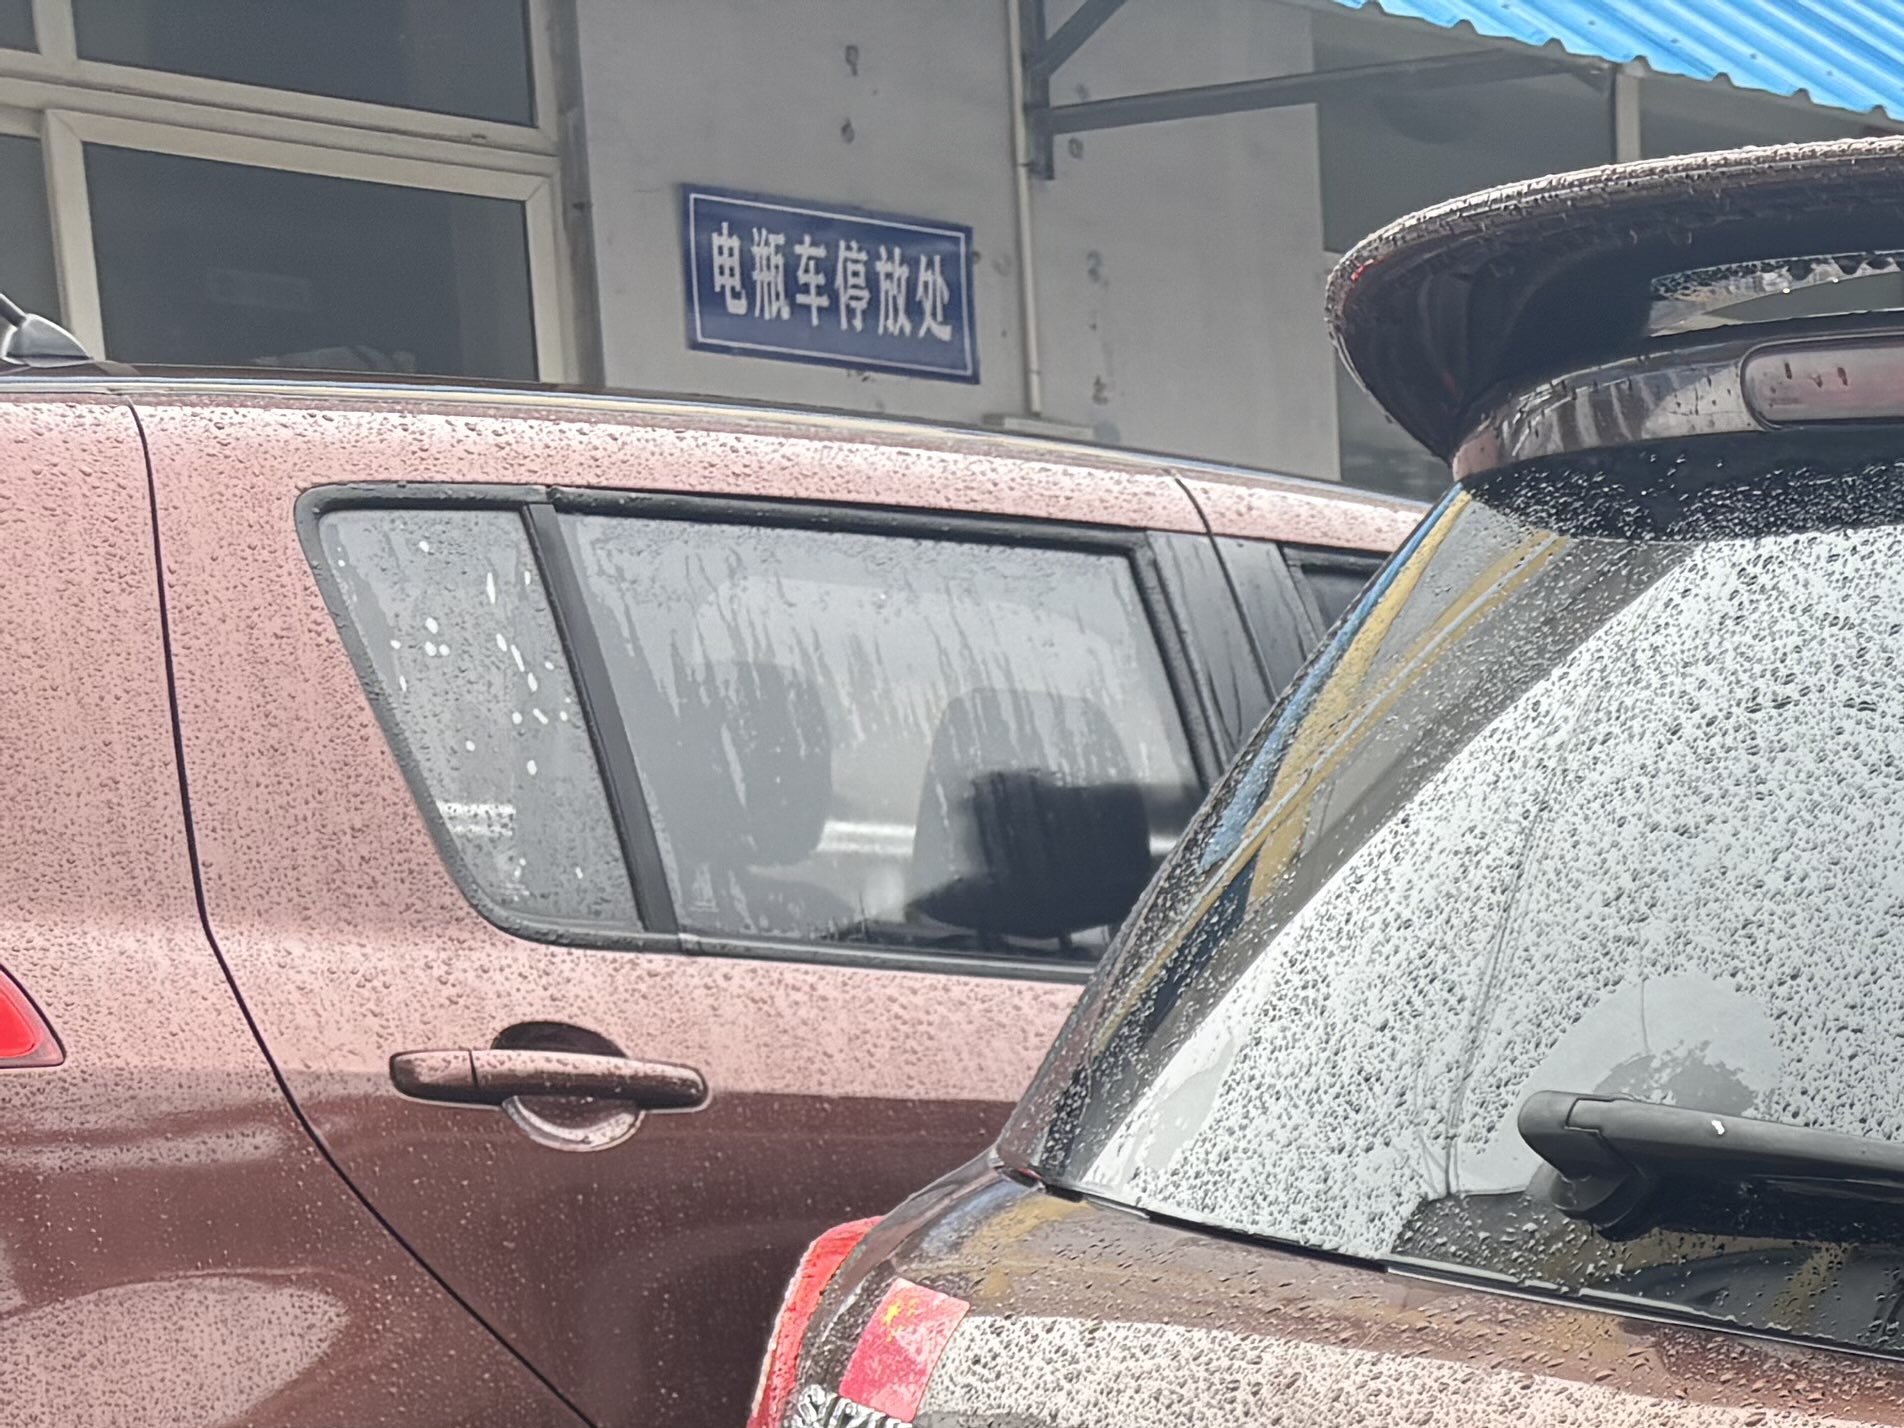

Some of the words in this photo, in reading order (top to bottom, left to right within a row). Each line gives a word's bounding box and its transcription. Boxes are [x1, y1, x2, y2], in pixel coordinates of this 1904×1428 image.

[711, 221, 952, 342] 电瓶车停放处
